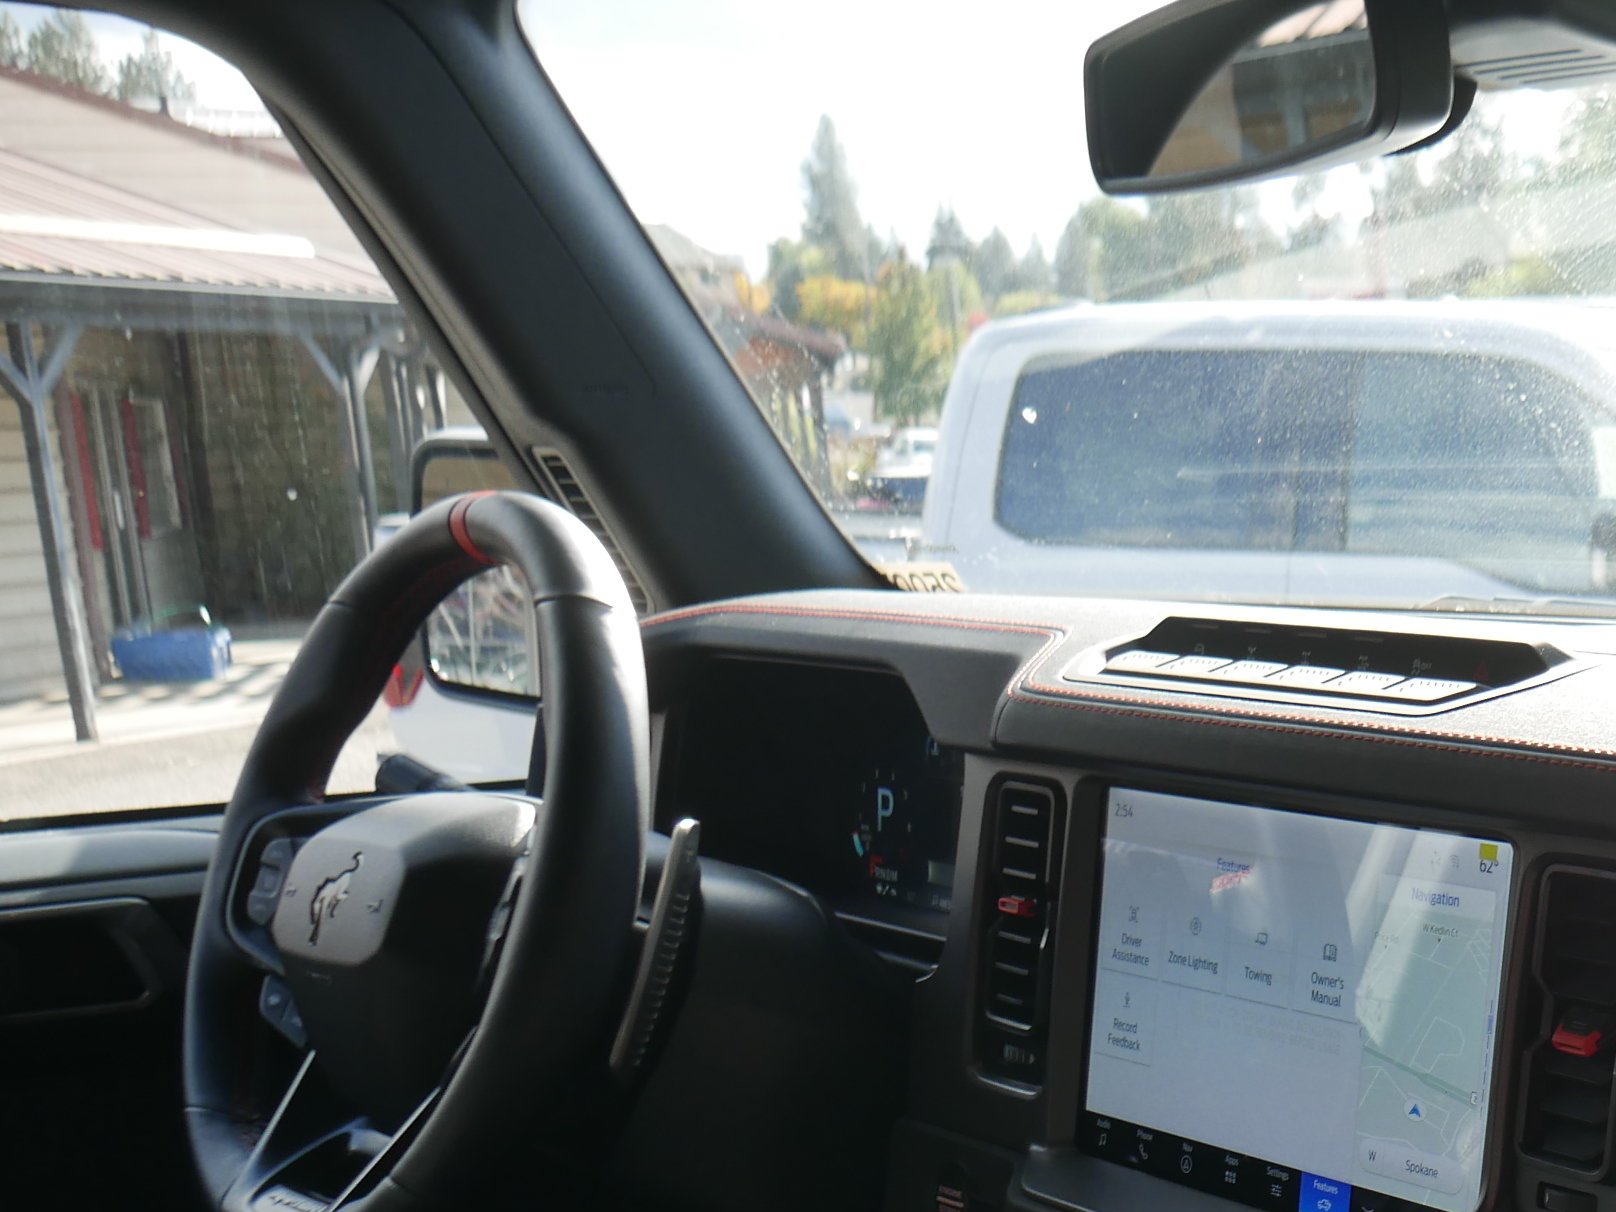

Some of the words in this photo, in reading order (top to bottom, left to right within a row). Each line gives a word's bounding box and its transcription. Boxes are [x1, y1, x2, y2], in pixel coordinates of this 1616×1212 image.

[1114, 801, 1134, 818] 2:54
[1216, 857, 1251, 874] Features
[1411, 887, 1461, 908] Navigation
[1121, 932, 1143, 949] Driver
[1111, 948, 1150, 968] Assistance
[1167, 950, 1185, 966] Zone
[1187, 954, 1219, 975] Lighting
[1244, 967, 1273, 987] Towing
[1310, 971, 1345, 990] Owner's
[1310, 989, 1342, 1008] Manual
[1113, 1017, 1138, 1035] Record
[1107, 1032, 1141, 1052] Feedback
[1368, 1149, 1376, 1161] W
[1266, 1166, 1290, 1182] Settings
[1405, 1158, 1440, 1179] Spokane
[1313, 1179, 1339, 1196] Features
